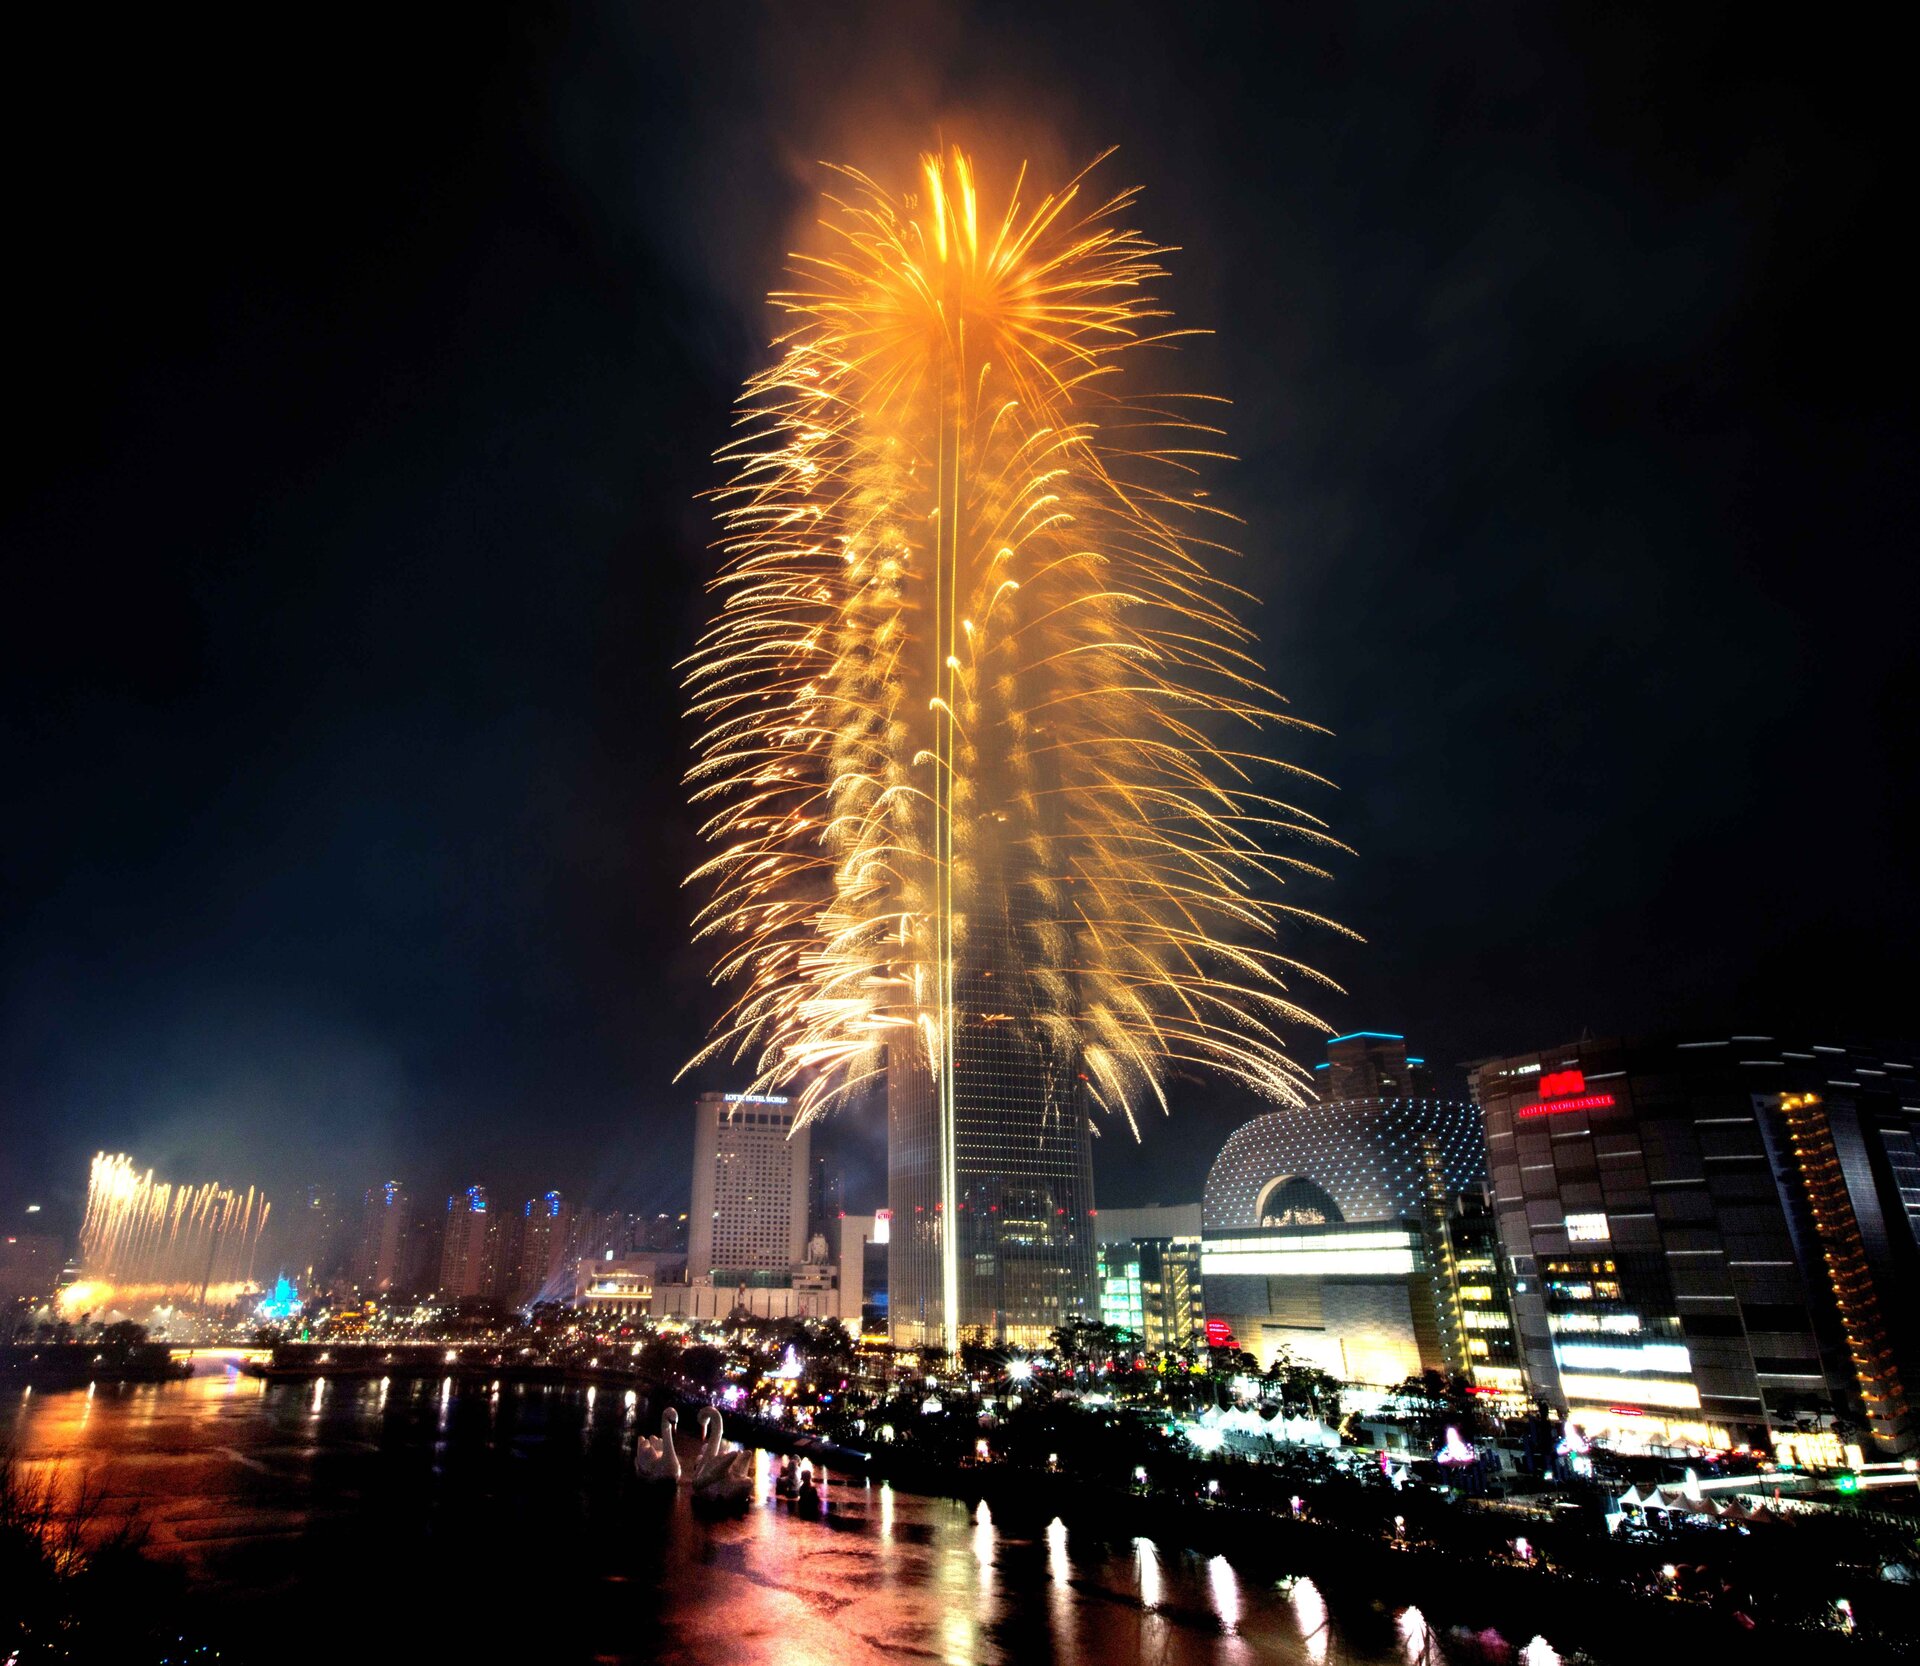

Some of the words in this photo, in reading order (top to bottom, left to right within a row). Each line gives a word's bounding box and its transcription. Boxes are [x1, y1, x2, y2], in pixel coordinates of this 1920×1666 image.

[745, 1095, 766, 1103] HOTEL
[766, 1096, 788, 1104] WORLD
[1550, 1100, 1584, 1112] WORLD
